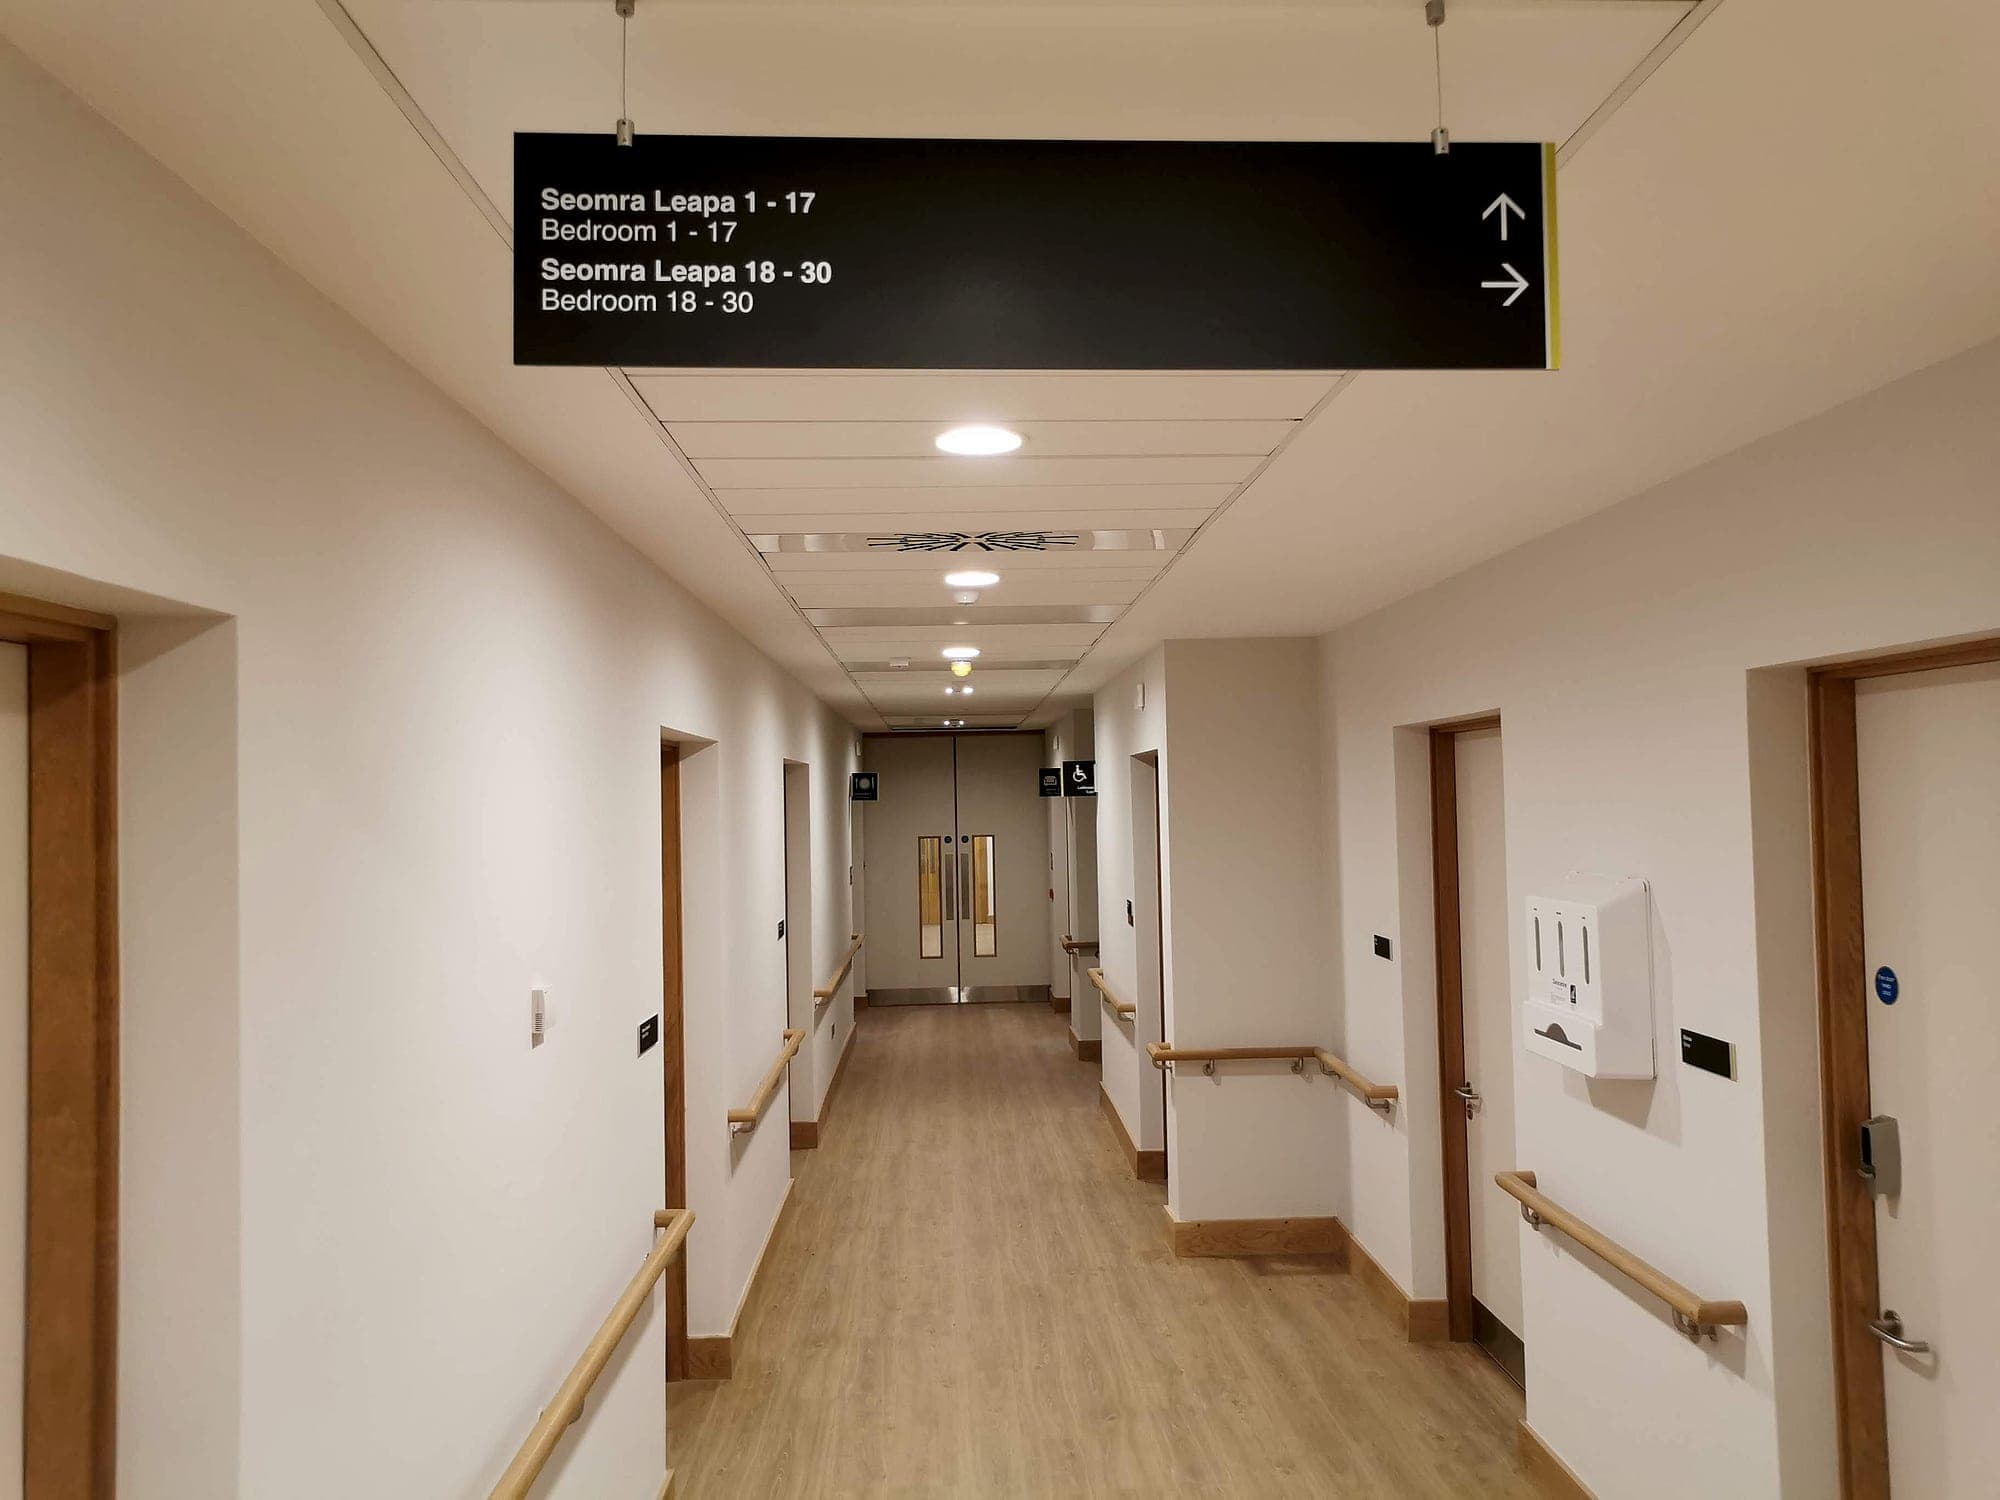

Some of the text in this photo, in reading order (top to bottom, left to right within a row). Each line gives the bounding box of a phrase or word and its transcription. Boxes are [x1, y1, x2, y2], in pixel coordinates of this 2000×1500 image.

[541, 187, 646, 212] Seomra
[654, 189, 736, 219] Leapa
[744, 190, 756, 213] 1
[785, 191, 816, 214] 17
[541, 217, 657, 242] Bedroom
[666, 220, 677, 243] 1
[707, 220, 738, 243] 17
[541, 257, 833, 289] Seomra Leapa 18 - 30
[541, 287, 657, 312] Bedroom
[666, 289, 697, 313] 18
[721, 290, 754, 314] 30
